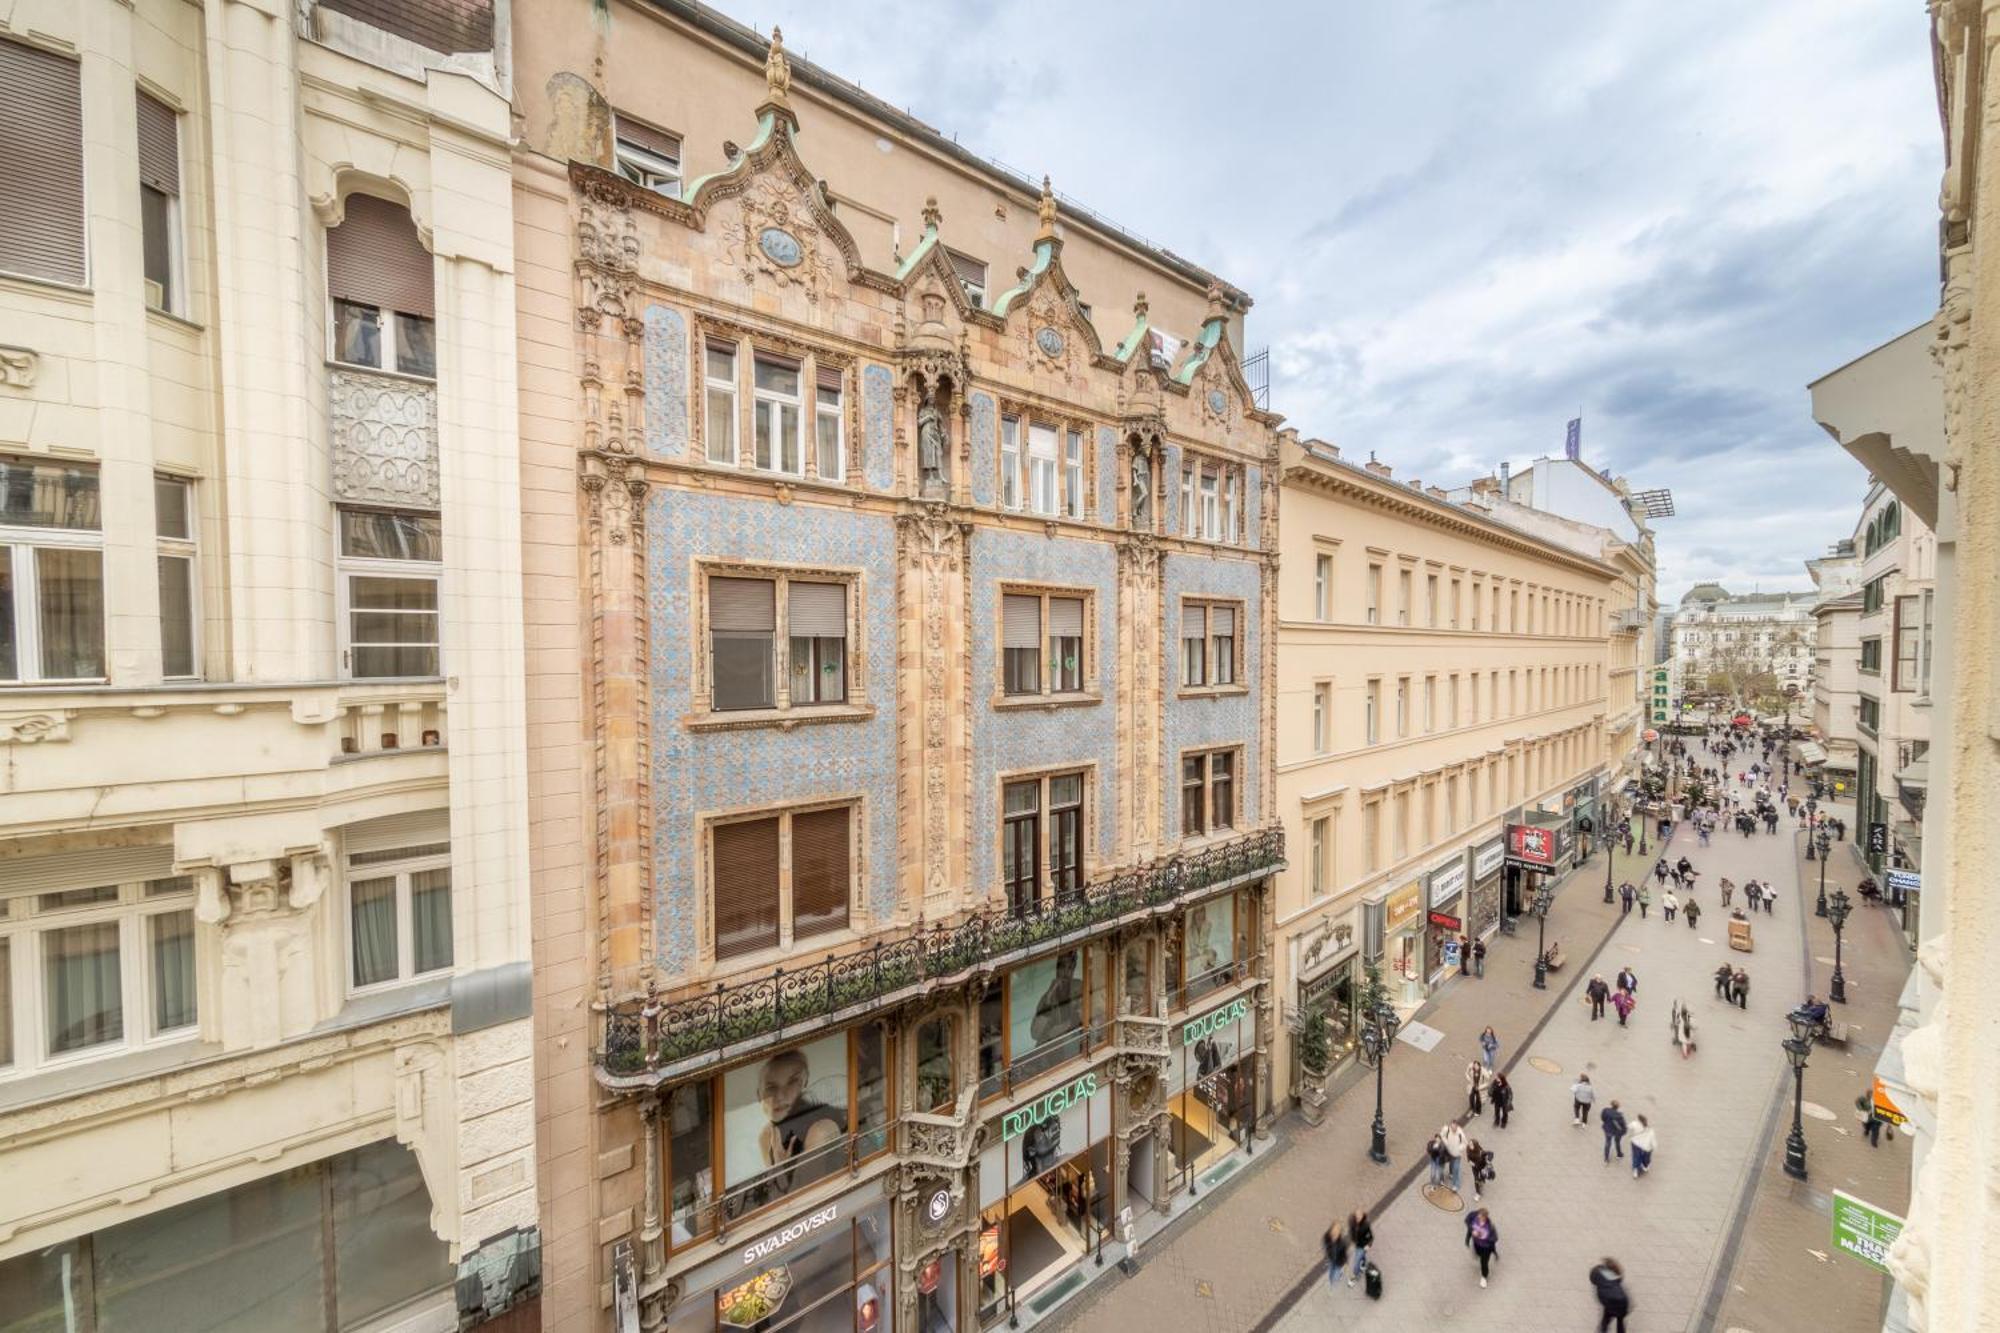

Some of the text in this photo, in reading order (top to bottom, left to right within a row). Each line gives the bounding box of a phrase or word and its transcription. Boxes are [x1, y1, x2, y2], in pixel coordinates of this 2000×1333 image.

[1654, 671, 1667, 721] anna
[1872, 827, 1884, 851] ZARA
[1183, 997, 1247, 1046] DOUGLAS
[1002, 1072, 1097, 1142] DOUGLAS
[743, 1204, 838, 1264] SWAROVSKI
